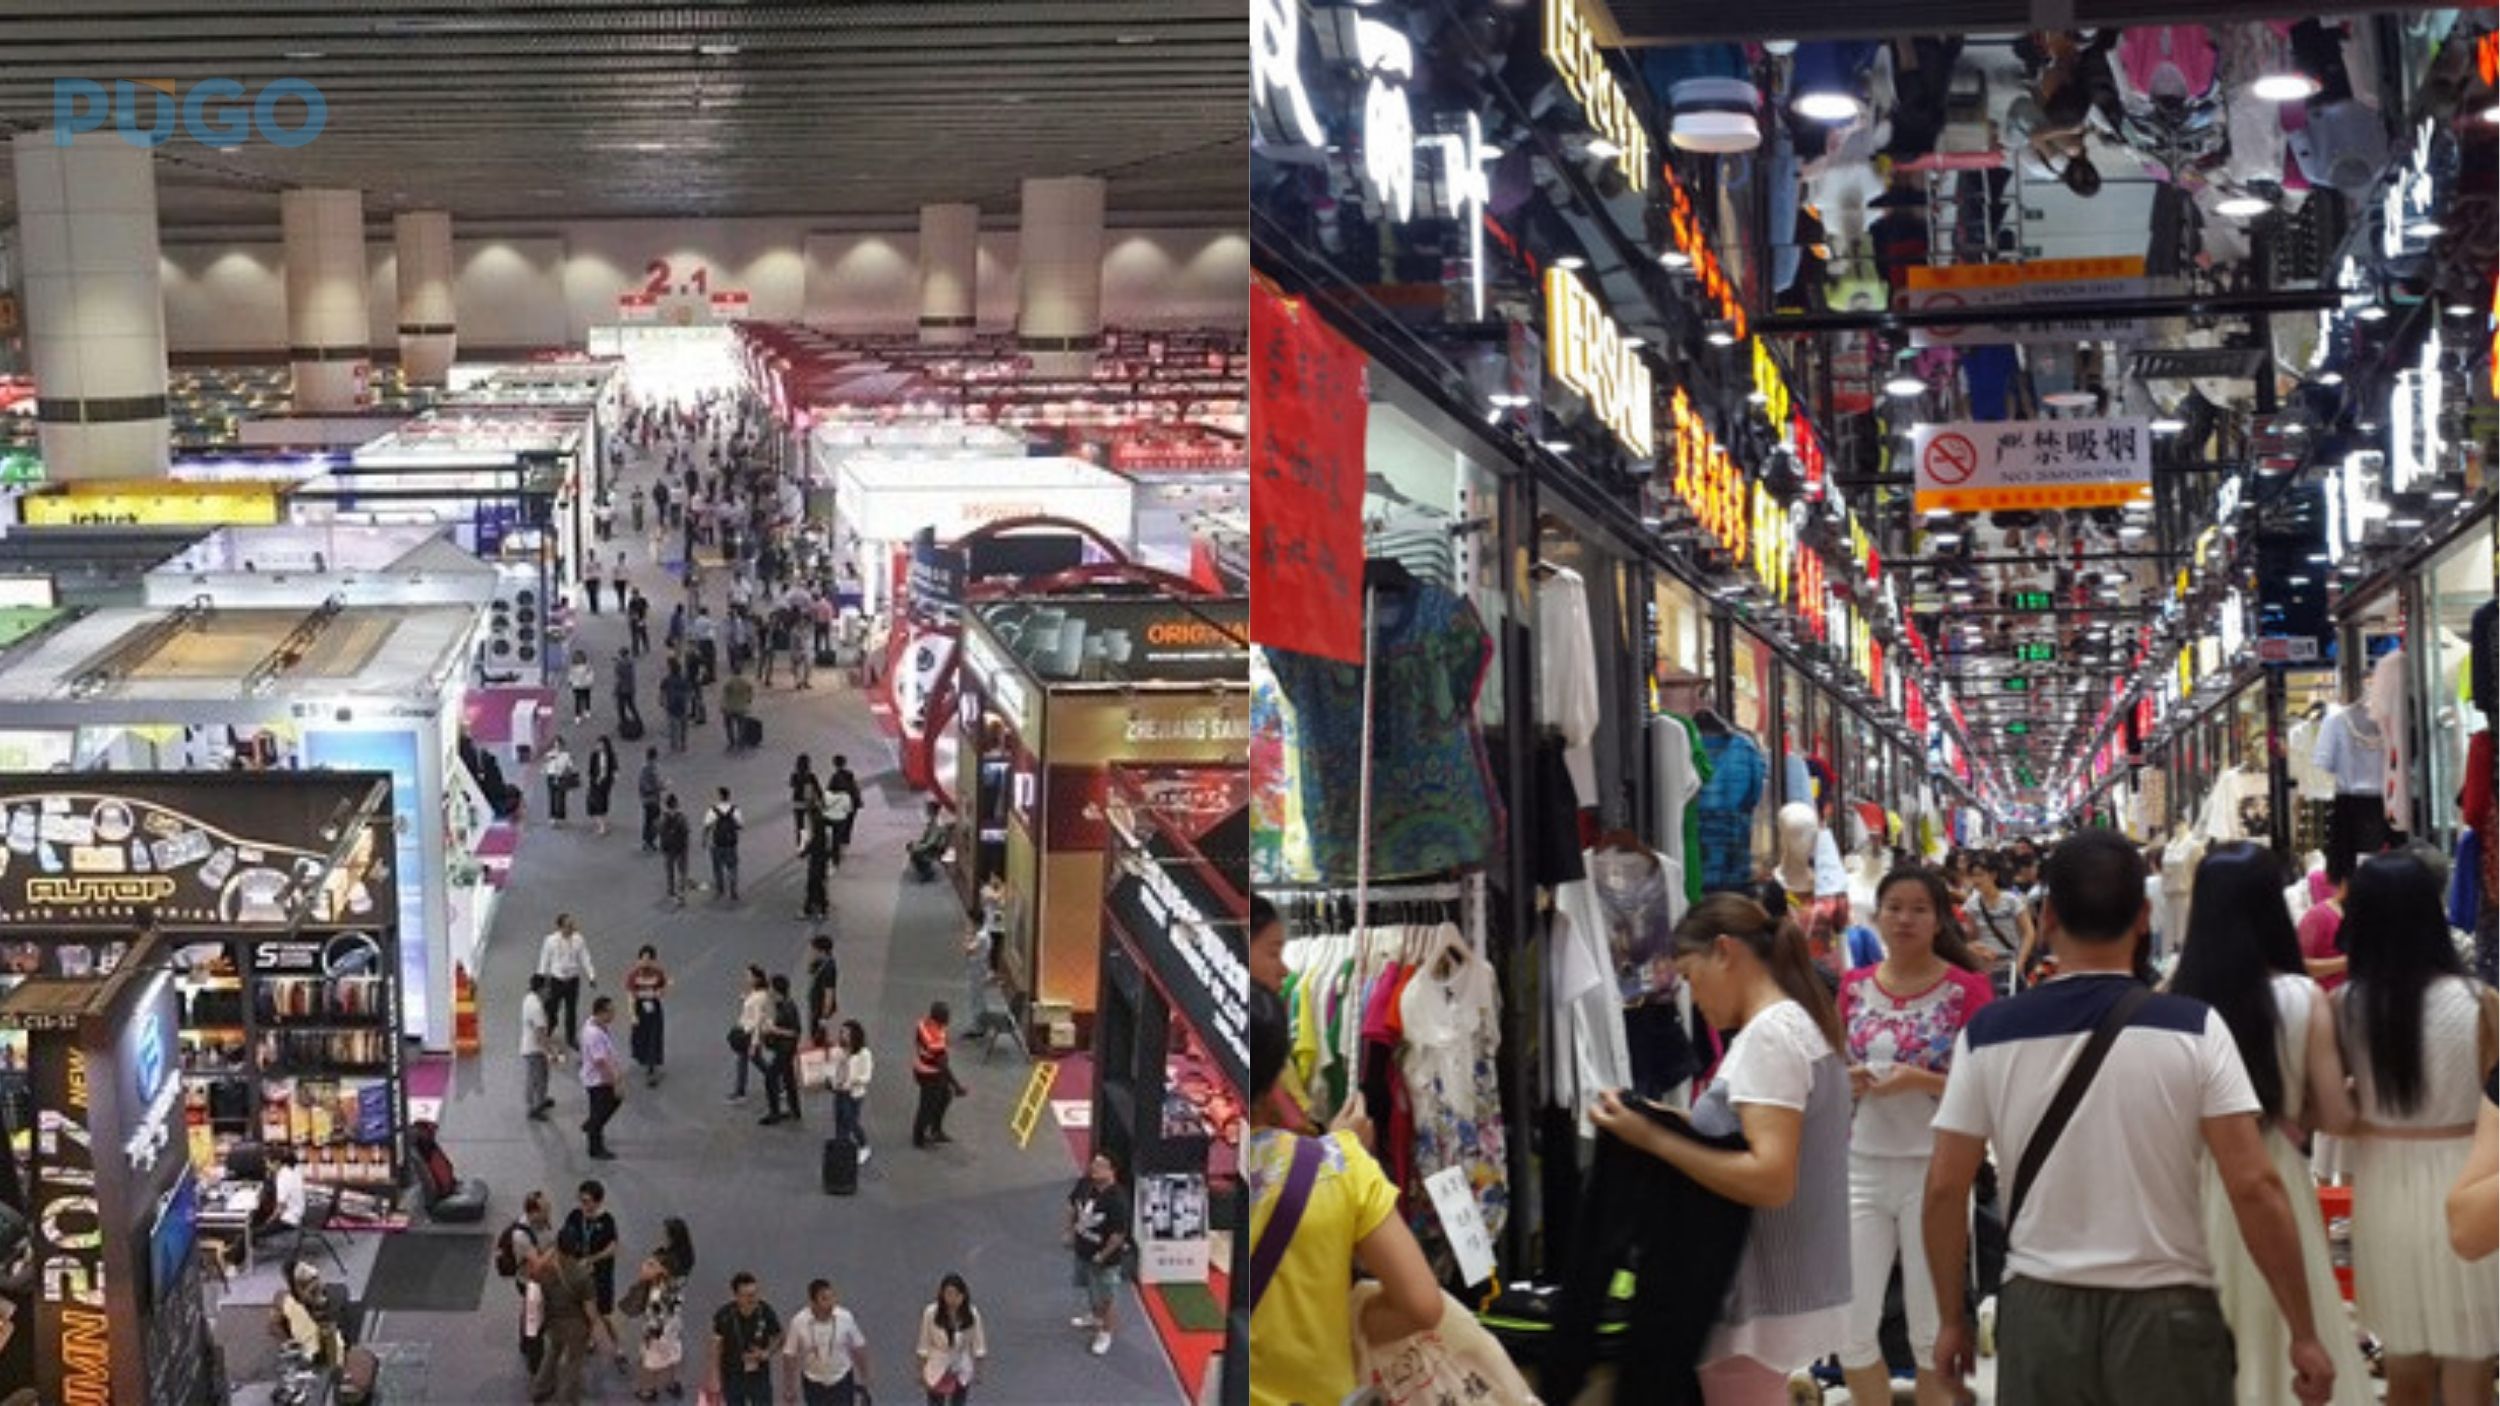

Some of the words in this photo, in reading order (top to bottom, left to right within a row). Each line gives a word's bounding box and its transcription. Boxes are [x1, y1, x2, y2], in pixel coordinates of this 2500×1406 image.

[646, 258, 707, 297] 2.1
[1995, 427, 2137, 466] 严禁吸烟
[37, 1108, 106, 1307] 2017
